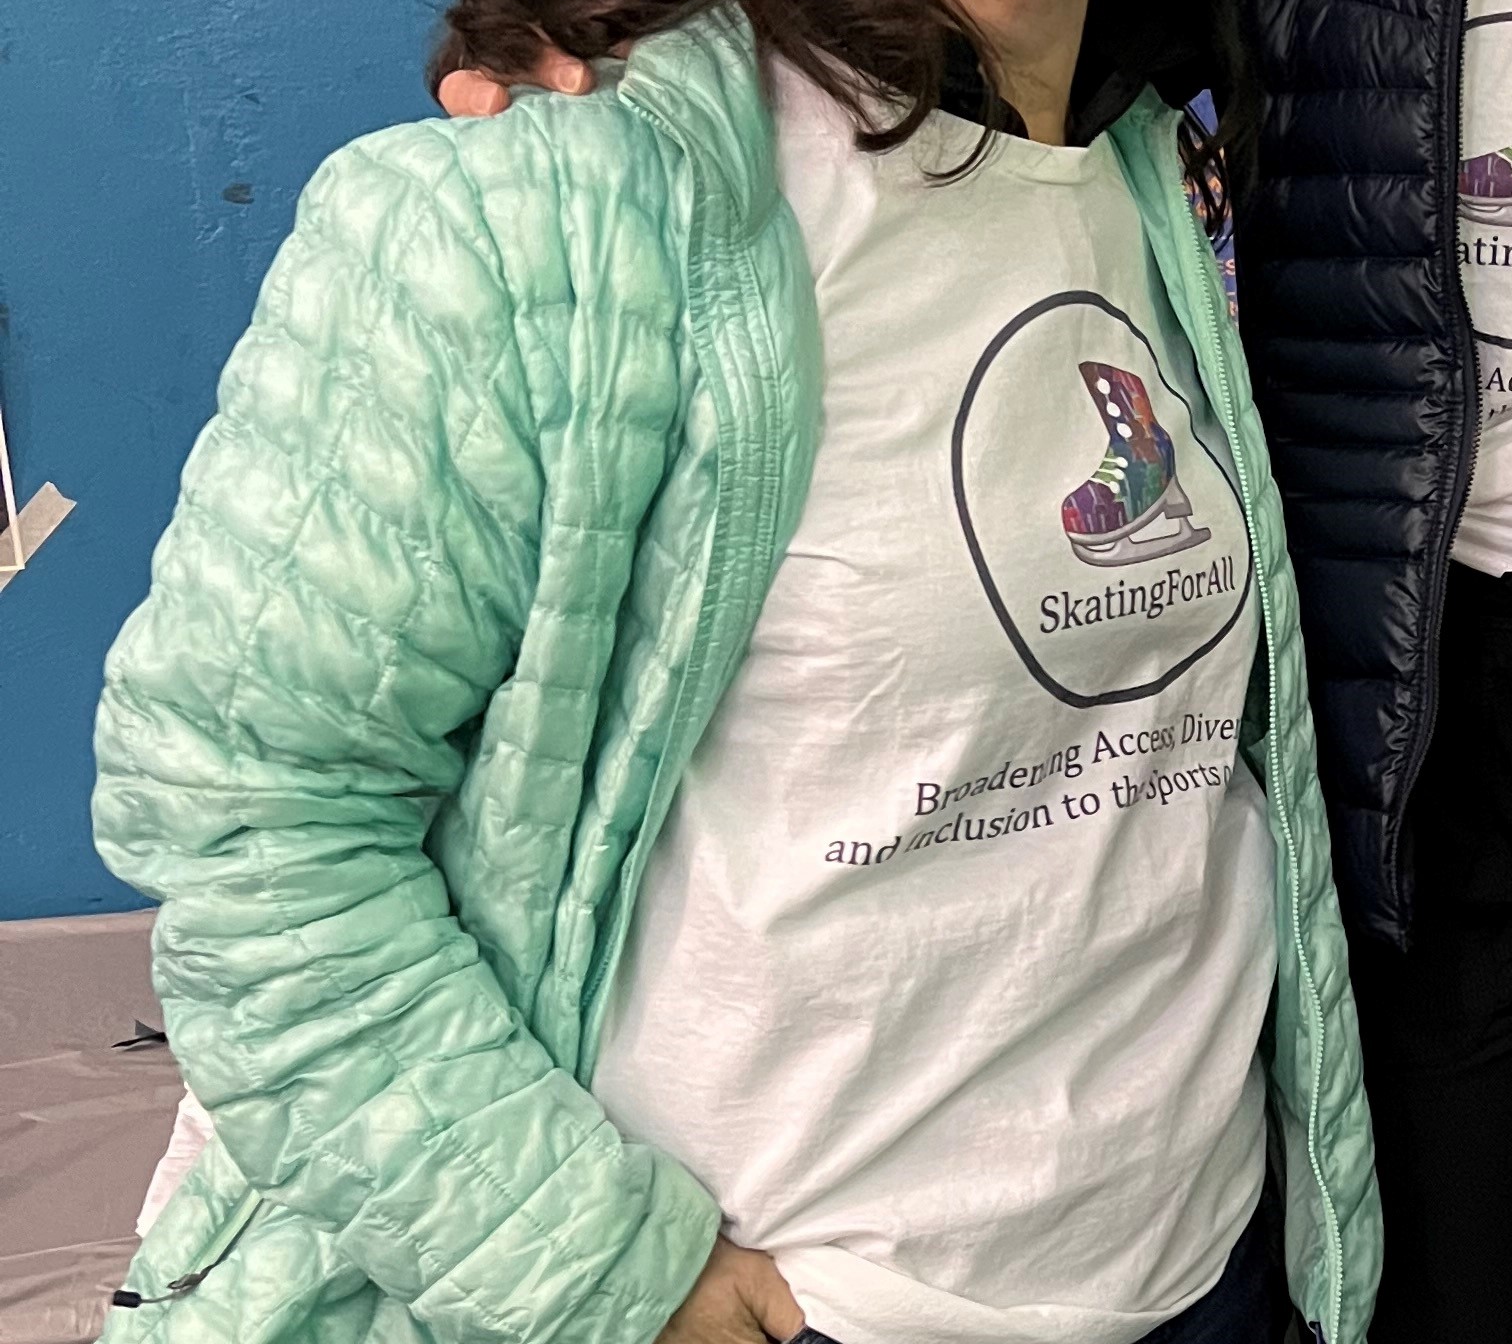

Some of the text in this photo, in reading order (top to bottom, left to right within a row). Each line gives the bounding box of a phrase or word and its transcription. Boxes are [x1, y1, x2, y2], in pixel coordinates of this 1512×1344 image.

[1040, 555, 1236, 634] SkatingForAll
[824, 835, 903, 866] and
[1061, 791, 1101, 820] to
